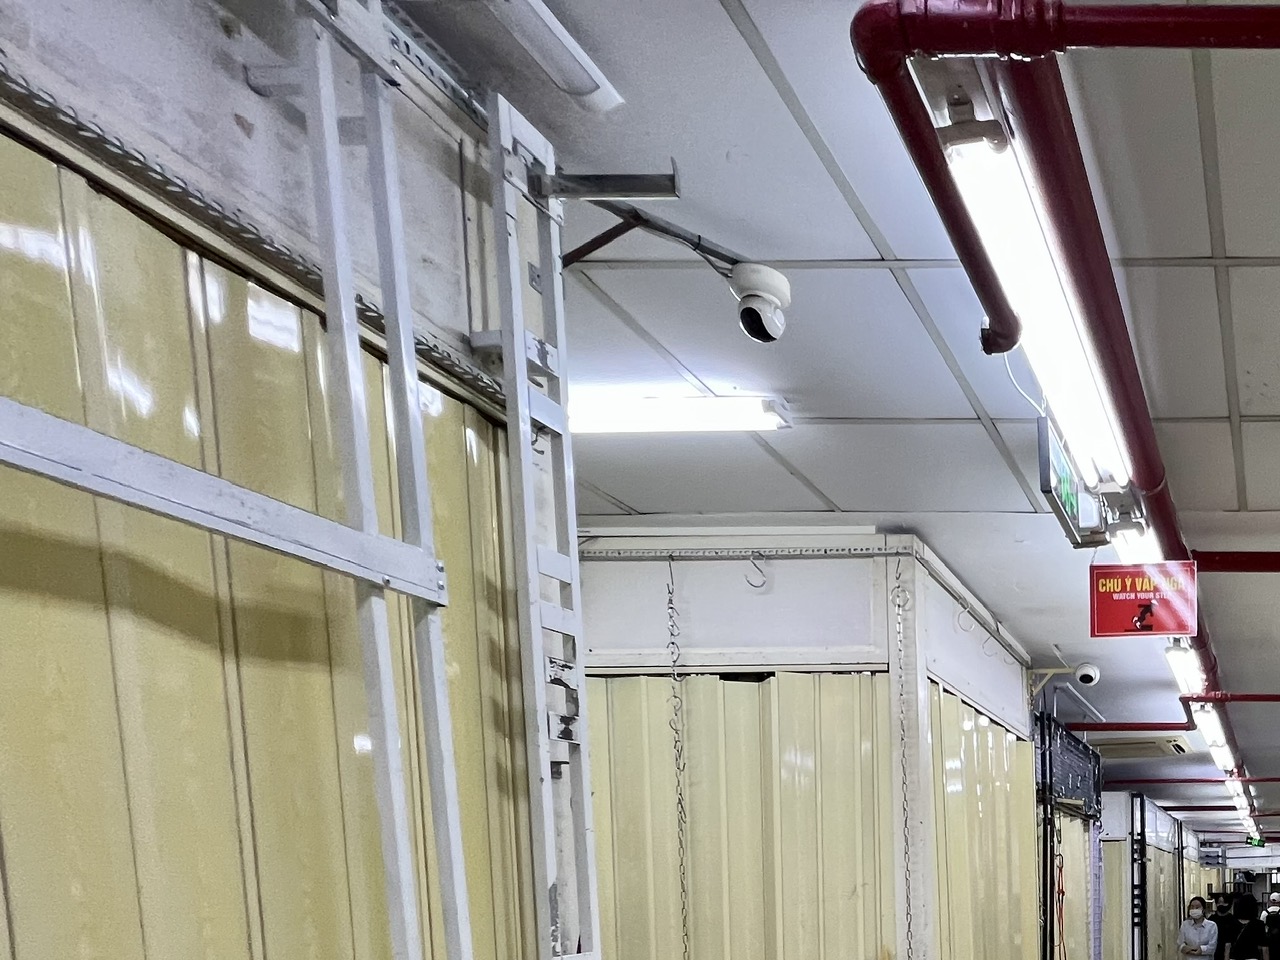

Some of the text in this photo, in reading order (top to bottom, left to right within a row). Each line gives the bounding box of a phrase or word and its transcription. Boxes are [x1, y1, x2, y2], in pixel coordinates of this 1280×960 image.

[1098, 576, 1121, 592] CHÚ
[1125, 575, 1132, 591] Ý
[1113, 592, 1135, 600] WATCH
